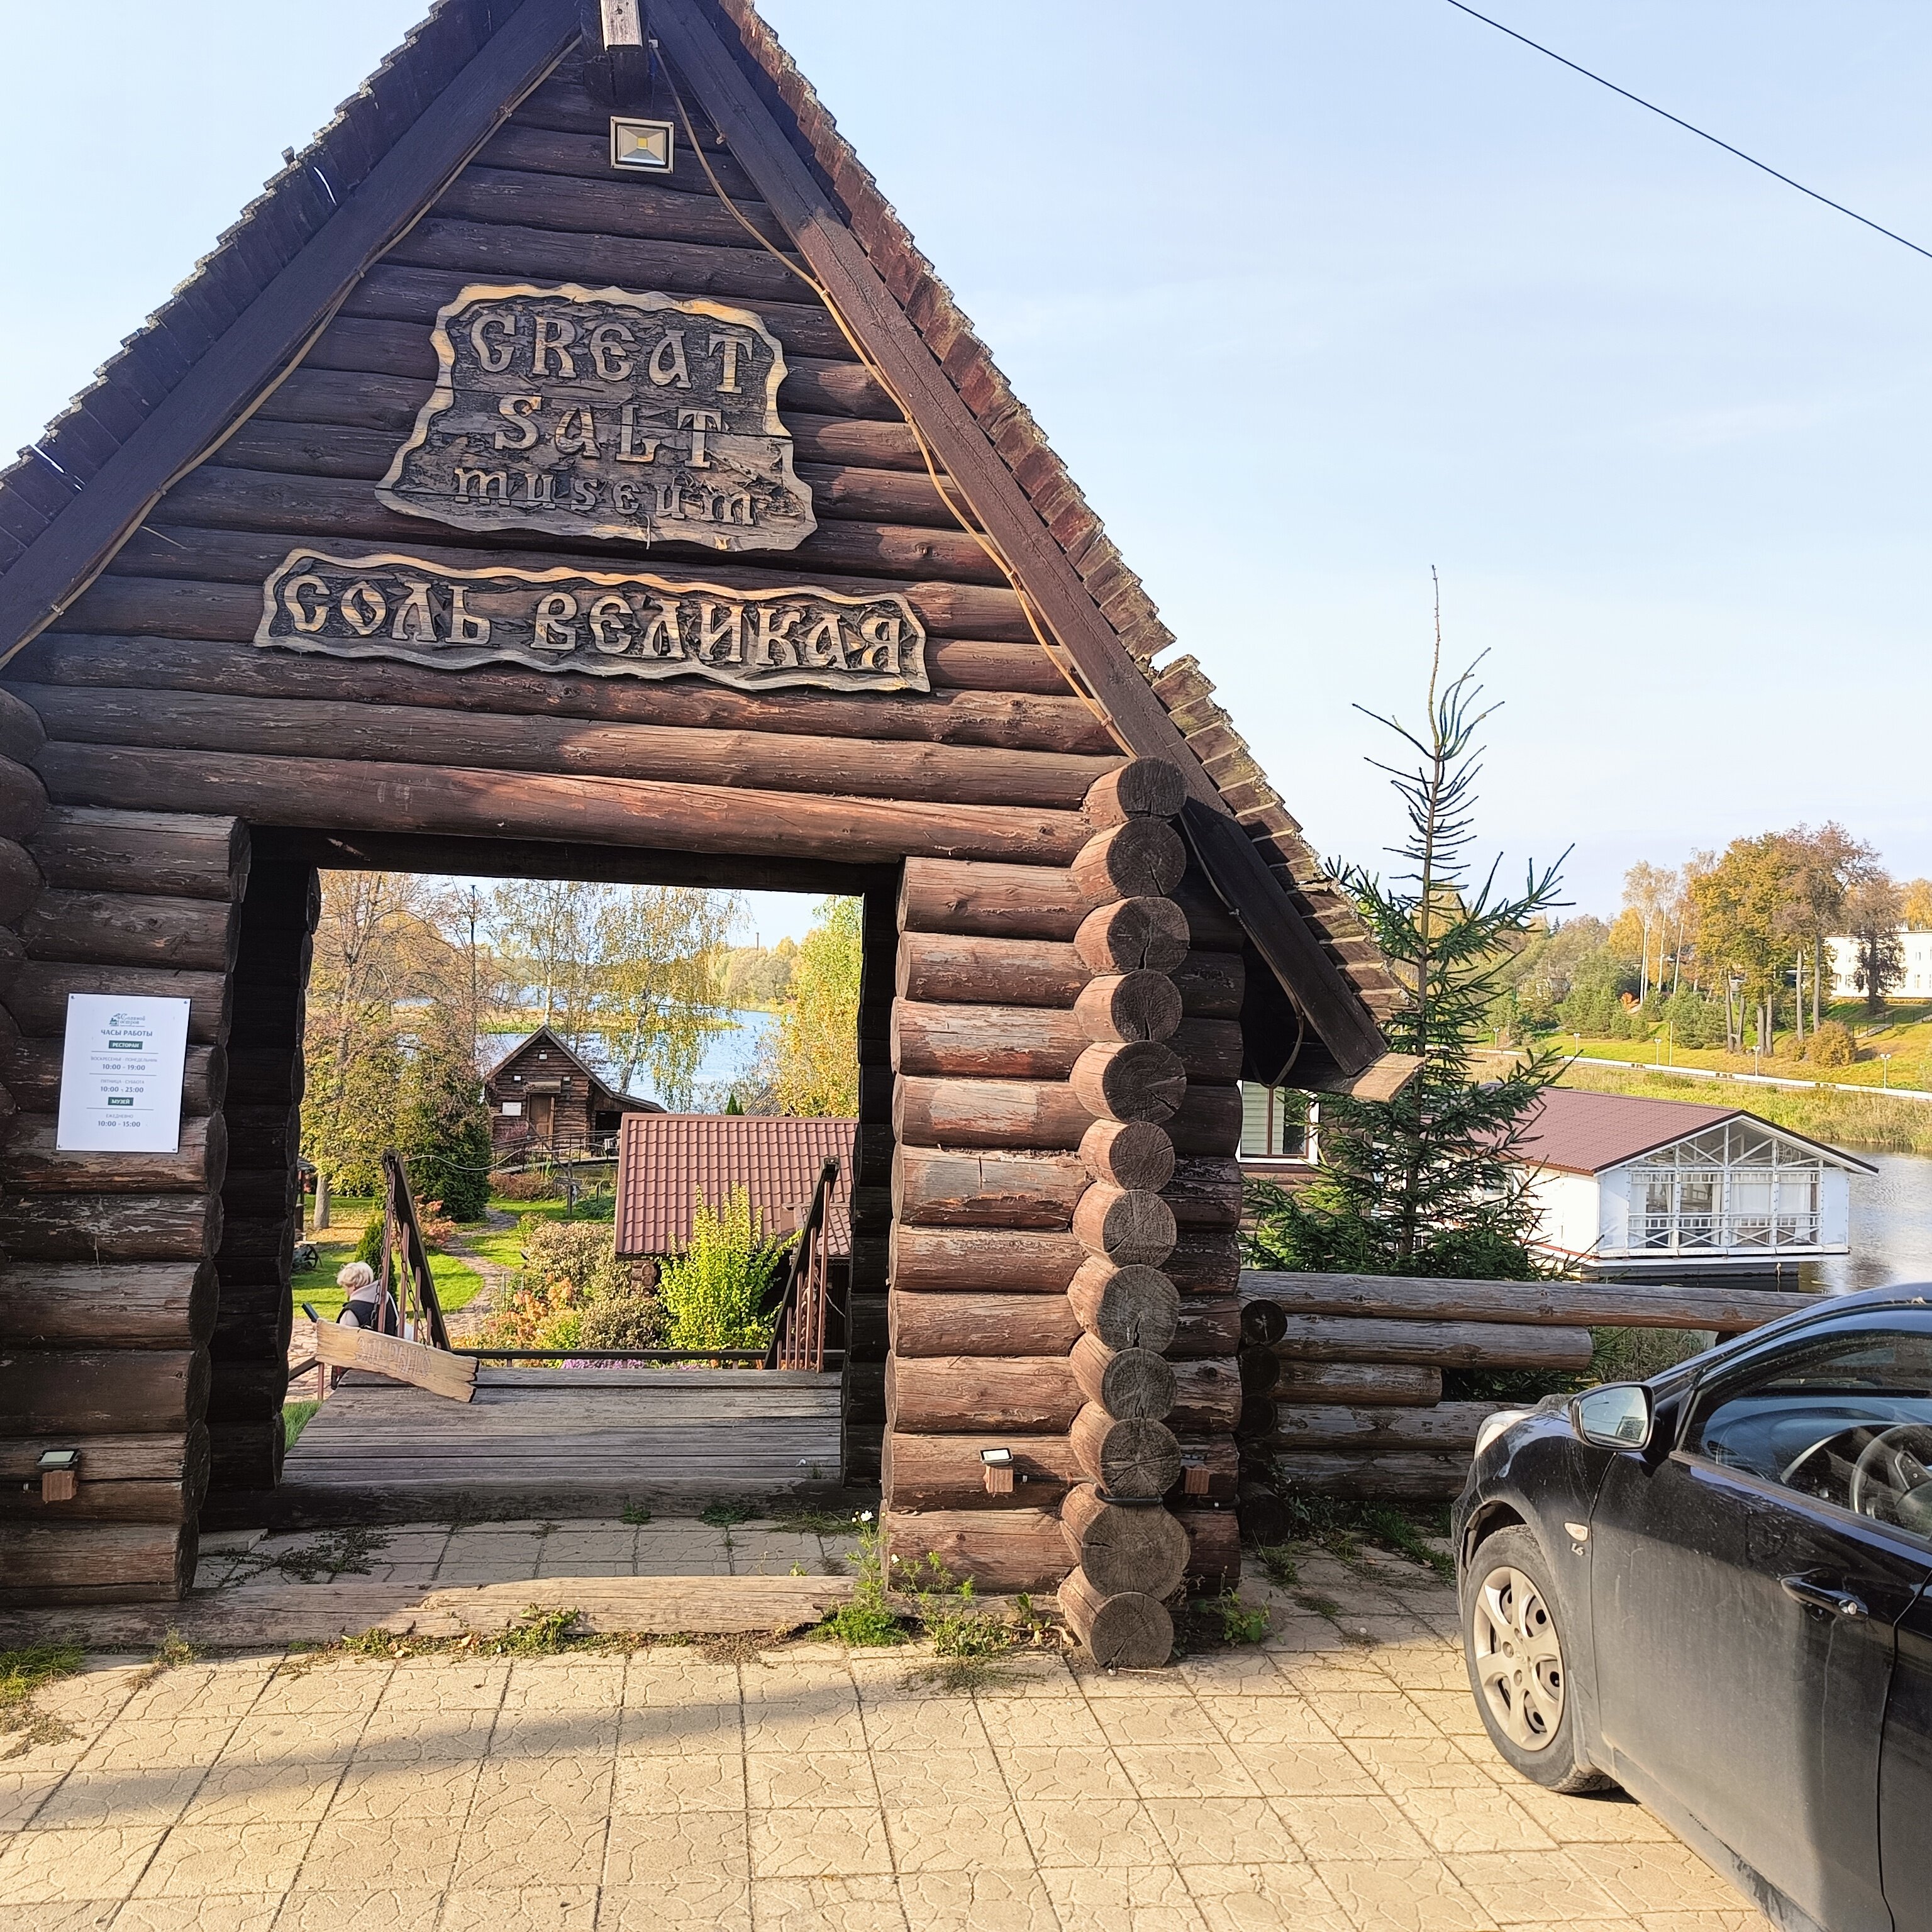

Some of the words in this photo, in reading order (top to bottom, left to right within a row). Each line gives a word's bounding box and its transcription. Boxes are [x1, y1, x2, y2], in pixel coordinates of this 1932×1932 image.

[470, 313, 754, 394] GREAT
[493, 393, 723, 469] SALT
[453, 467, 757, 526] museum
[283, 574, 492, 645] СОЛЬ
[531, 591, 901, 674] ВЕЛИКАЯ
[357, 1336, 432, 1379] ЗАКРЫТО
